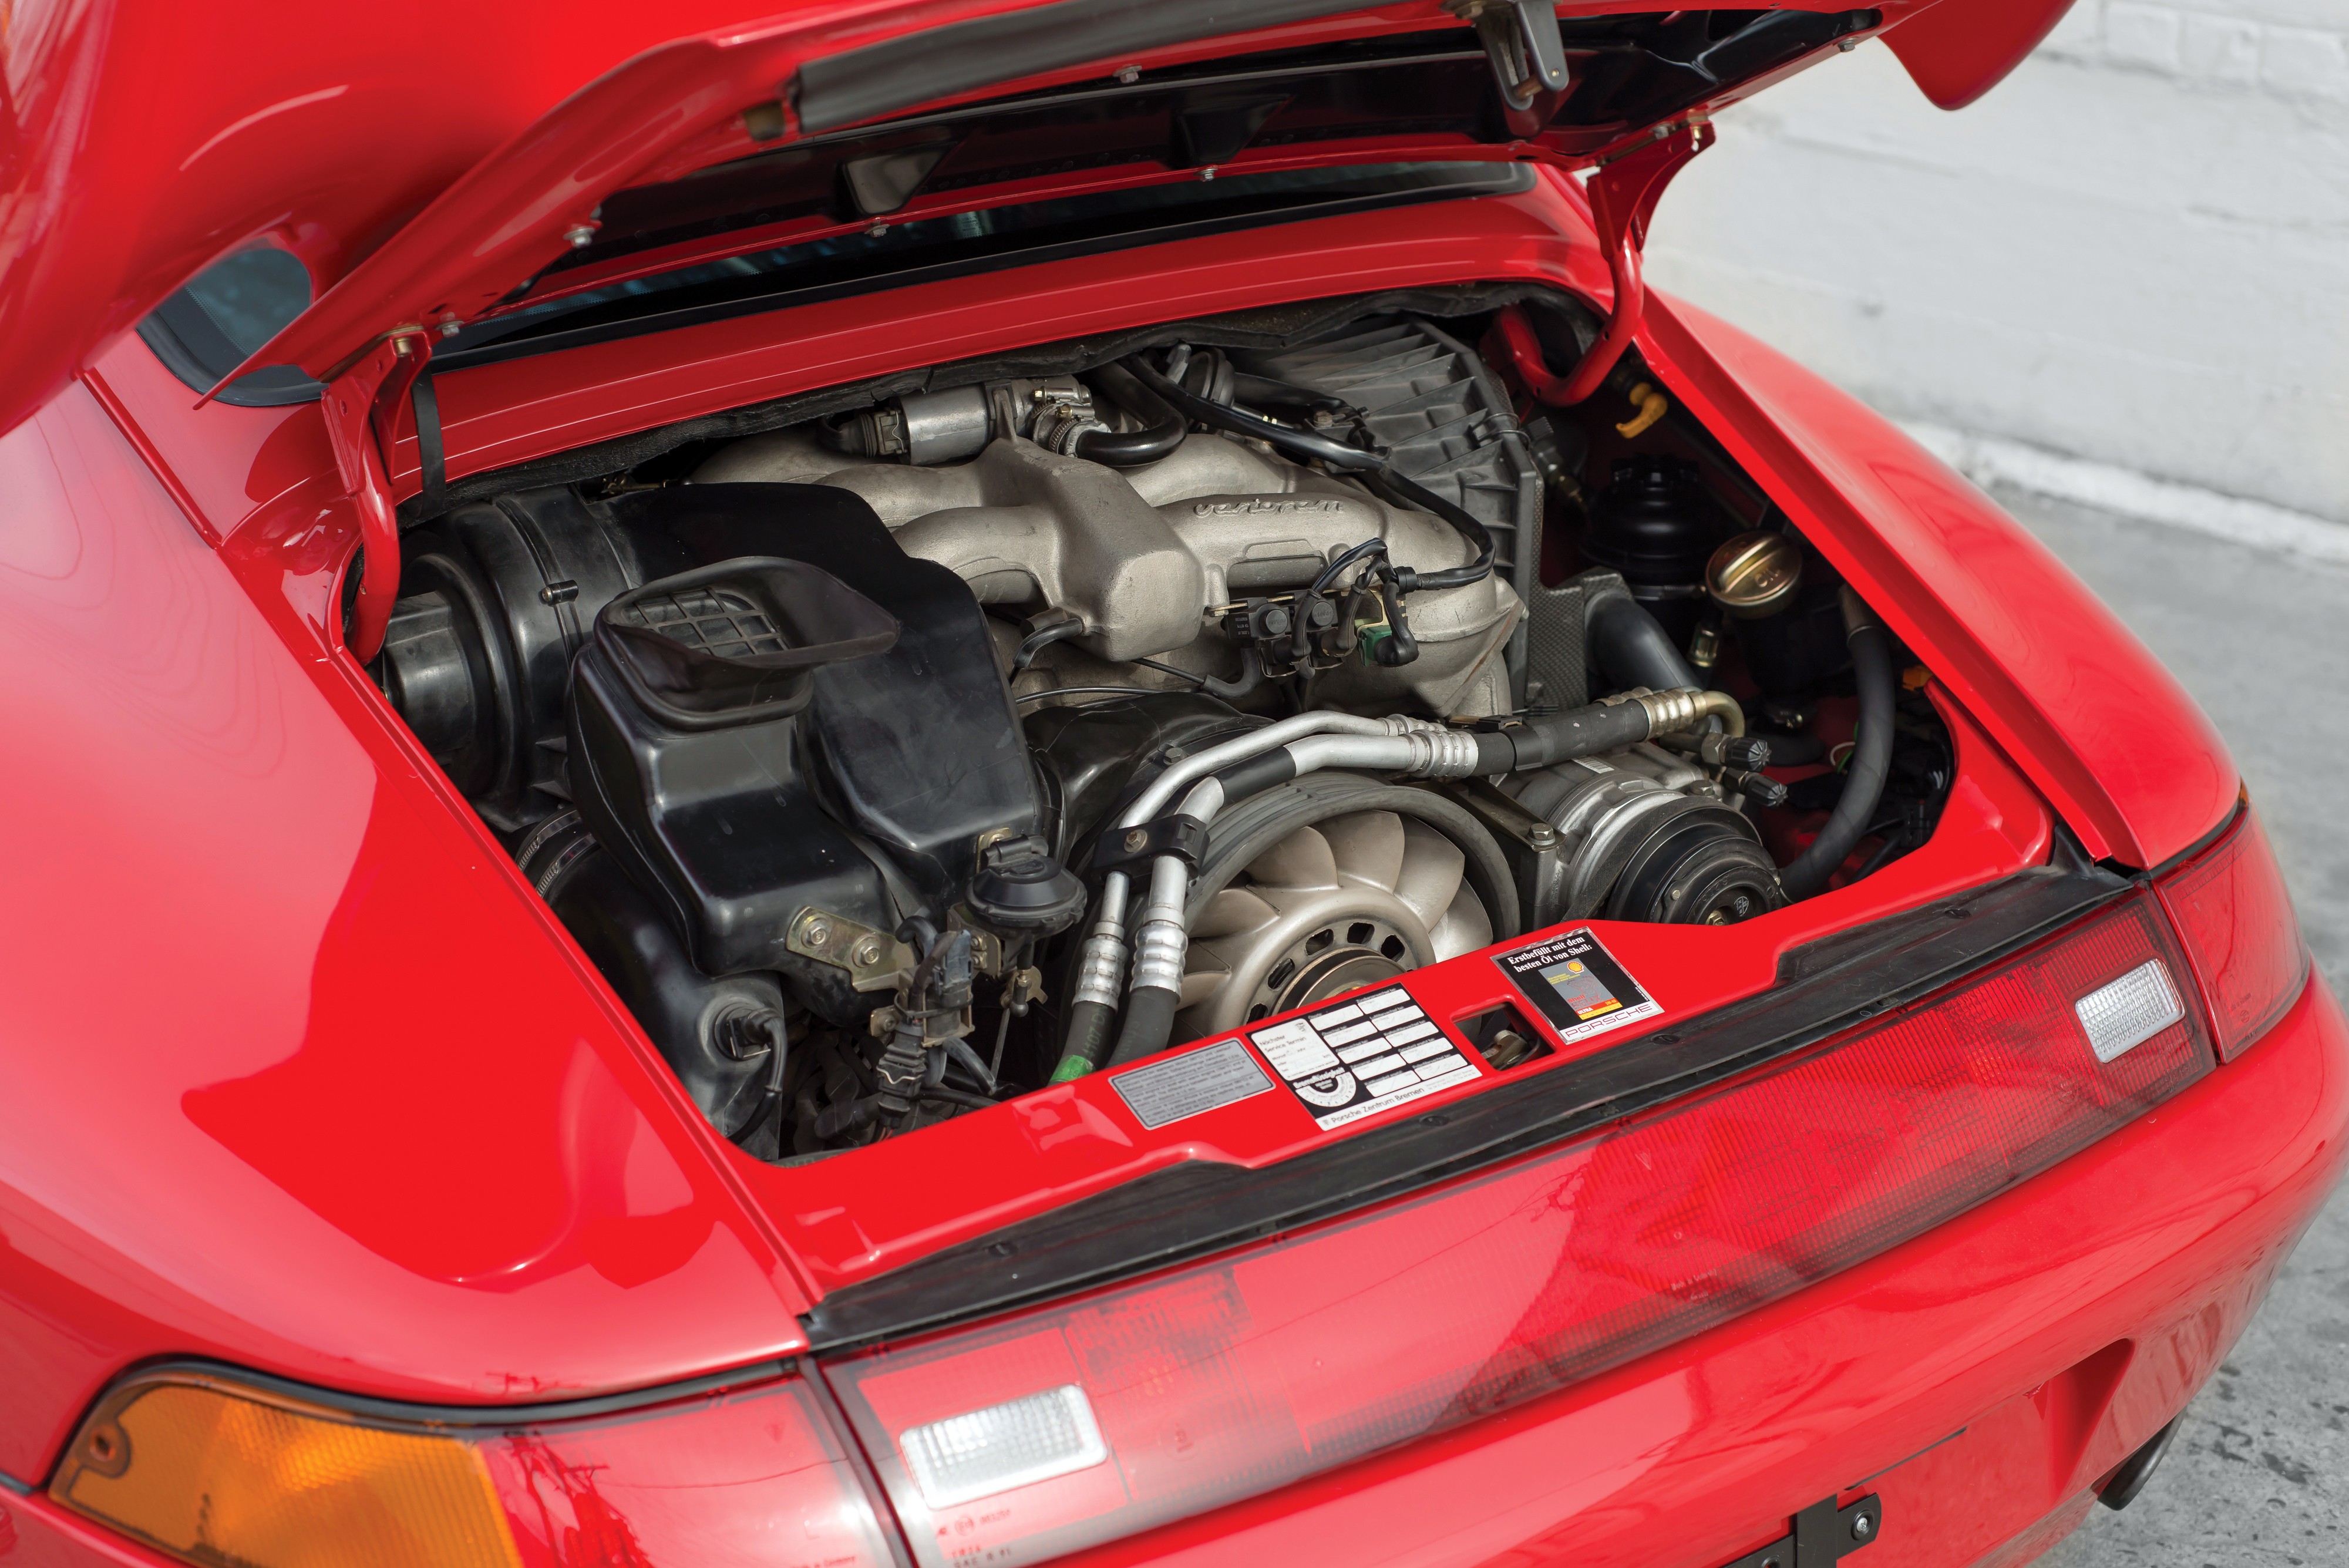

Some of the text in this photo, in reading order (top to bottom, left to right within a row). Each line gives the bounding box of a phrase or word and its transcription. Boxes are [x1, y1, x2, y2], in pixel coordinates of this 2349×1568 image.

[1507, 936, 1585, 965] Erstbefüllt mit dem
[1513, 944, 1593, 973] besten Öl von Shell:
[1566, 994, 1586, 1002] Shell
[1565, 1004, 1652, 1037] PORSCHE
[1331, 1087, 1424, 1123] Porsche Zentrum Bremen
